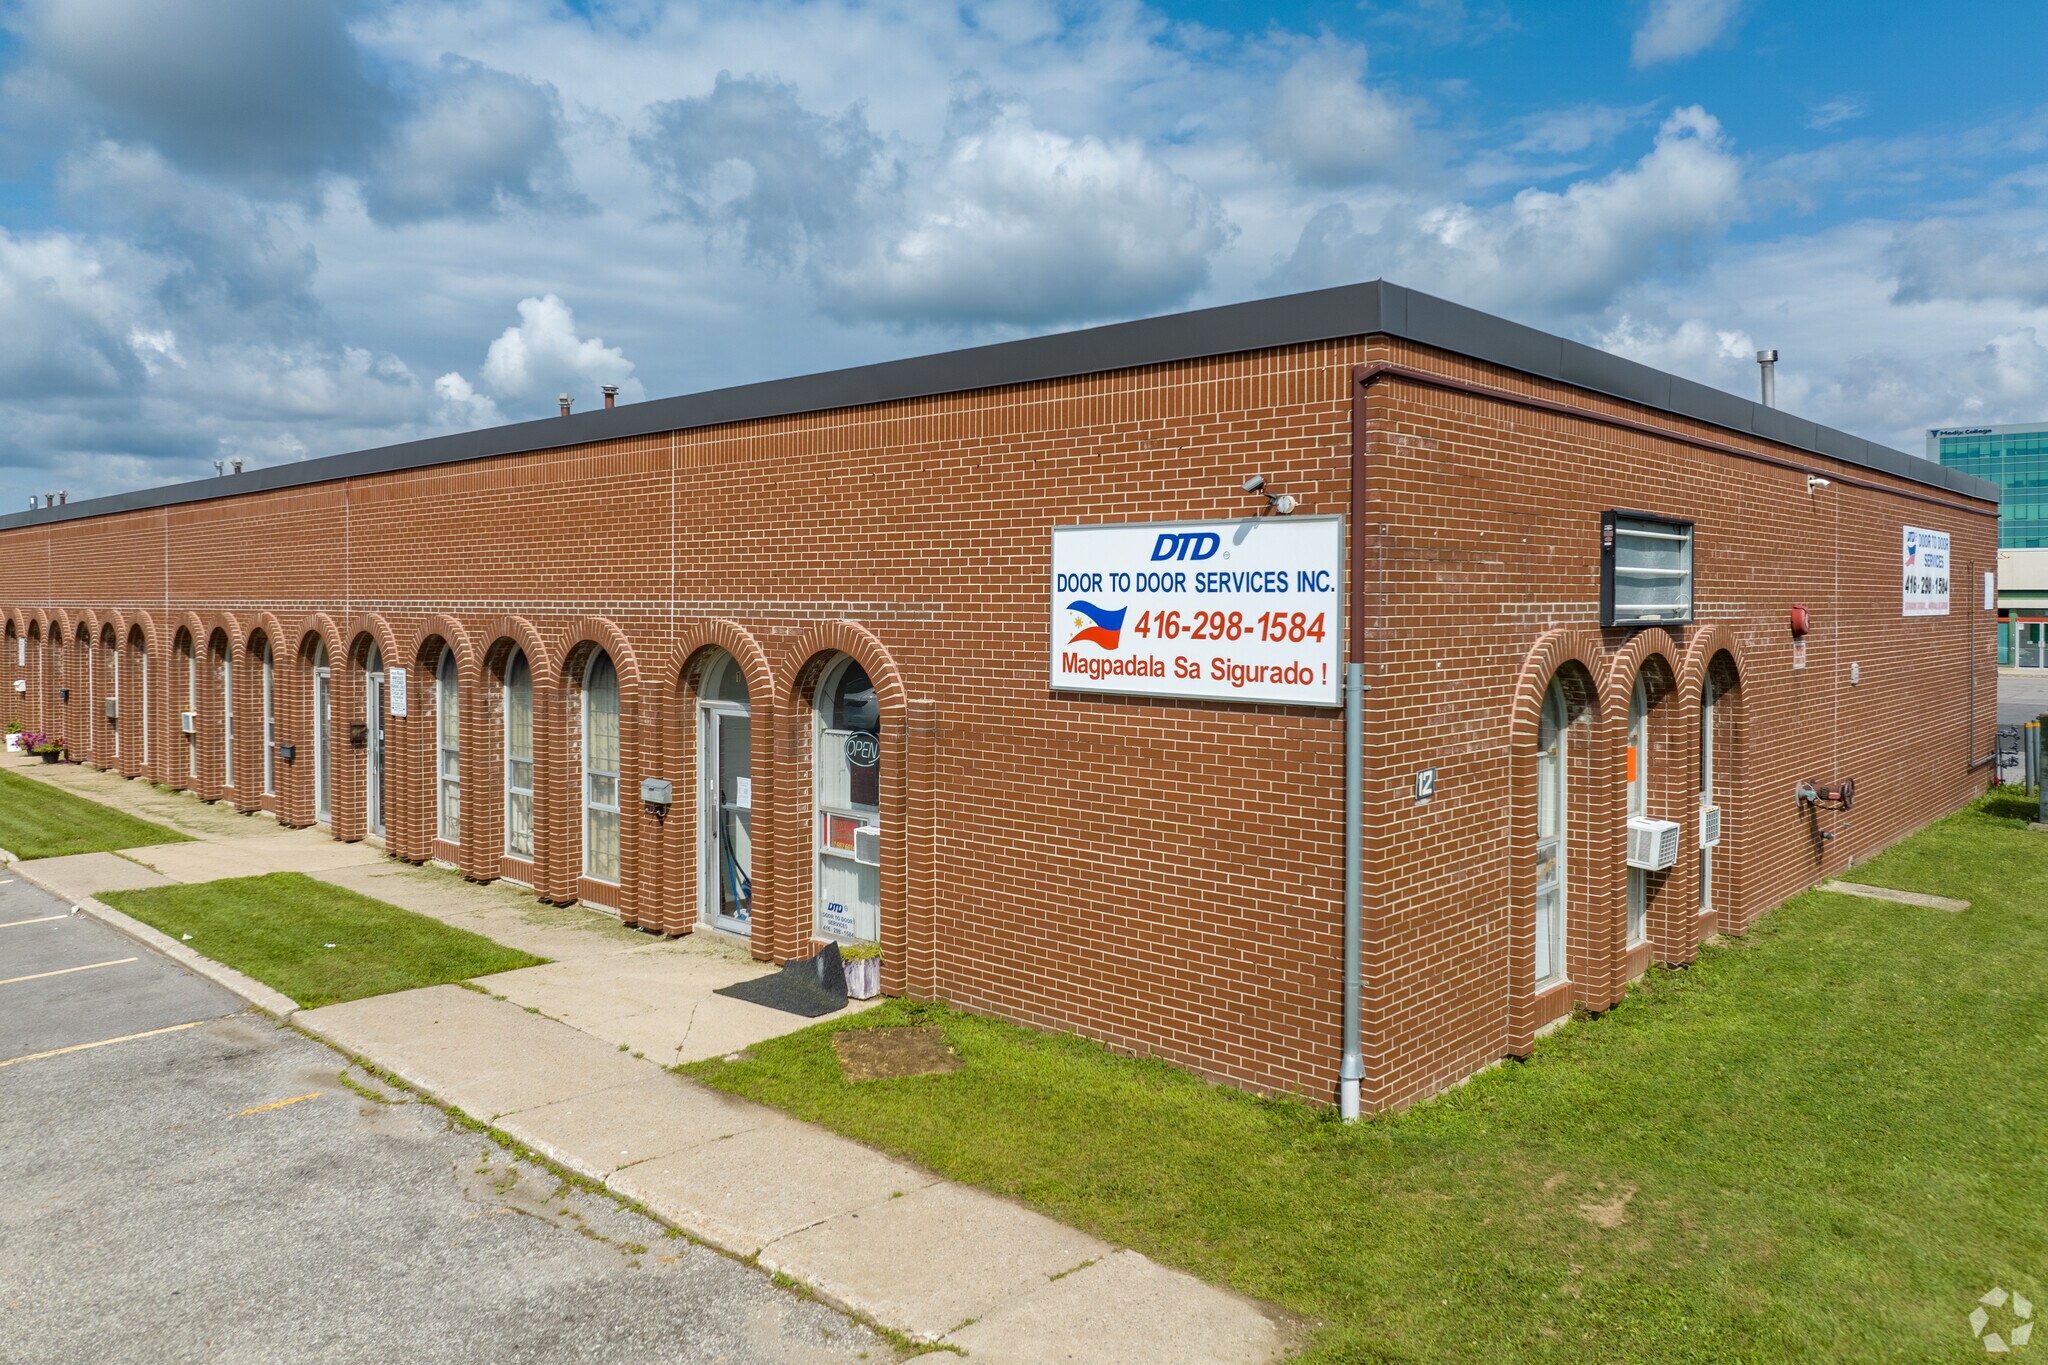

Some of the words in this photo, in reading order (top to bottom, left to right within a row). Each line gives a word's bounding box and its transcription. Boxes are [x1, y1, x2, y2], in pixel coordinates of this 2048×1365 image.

[1151, 532, 1221, 561] DTD
[1918, 533, 1931, 548] DOOR
[1938, 536, 1949, 551] DOOR
[1924, 553, 1944, 568] SERVICES
[1057, 572, 1102, 593] DOOR
[1109, 572, 1131, 592] TO
[1136, 572, 1186, 593] DOOR
[1195, 571, 1289, 593] SERVICES
[1297, 570, 1335, 593] INC.
[1134, 610, 1326, 643] 416-298-1584
[1062, 652, 1165, 680] Magpadala
[1174, 656, 1200, 679] Sa
[1211, 657, 1313, 688] Sigurado
[847, 740, 878, 759] OPEN
[1418, 770, 1433, 797] 12
[822, 912, 834, 920] DOOR
[828, 902, 843, 913] DTD
[828, 920, 848, 929] SERVICES
